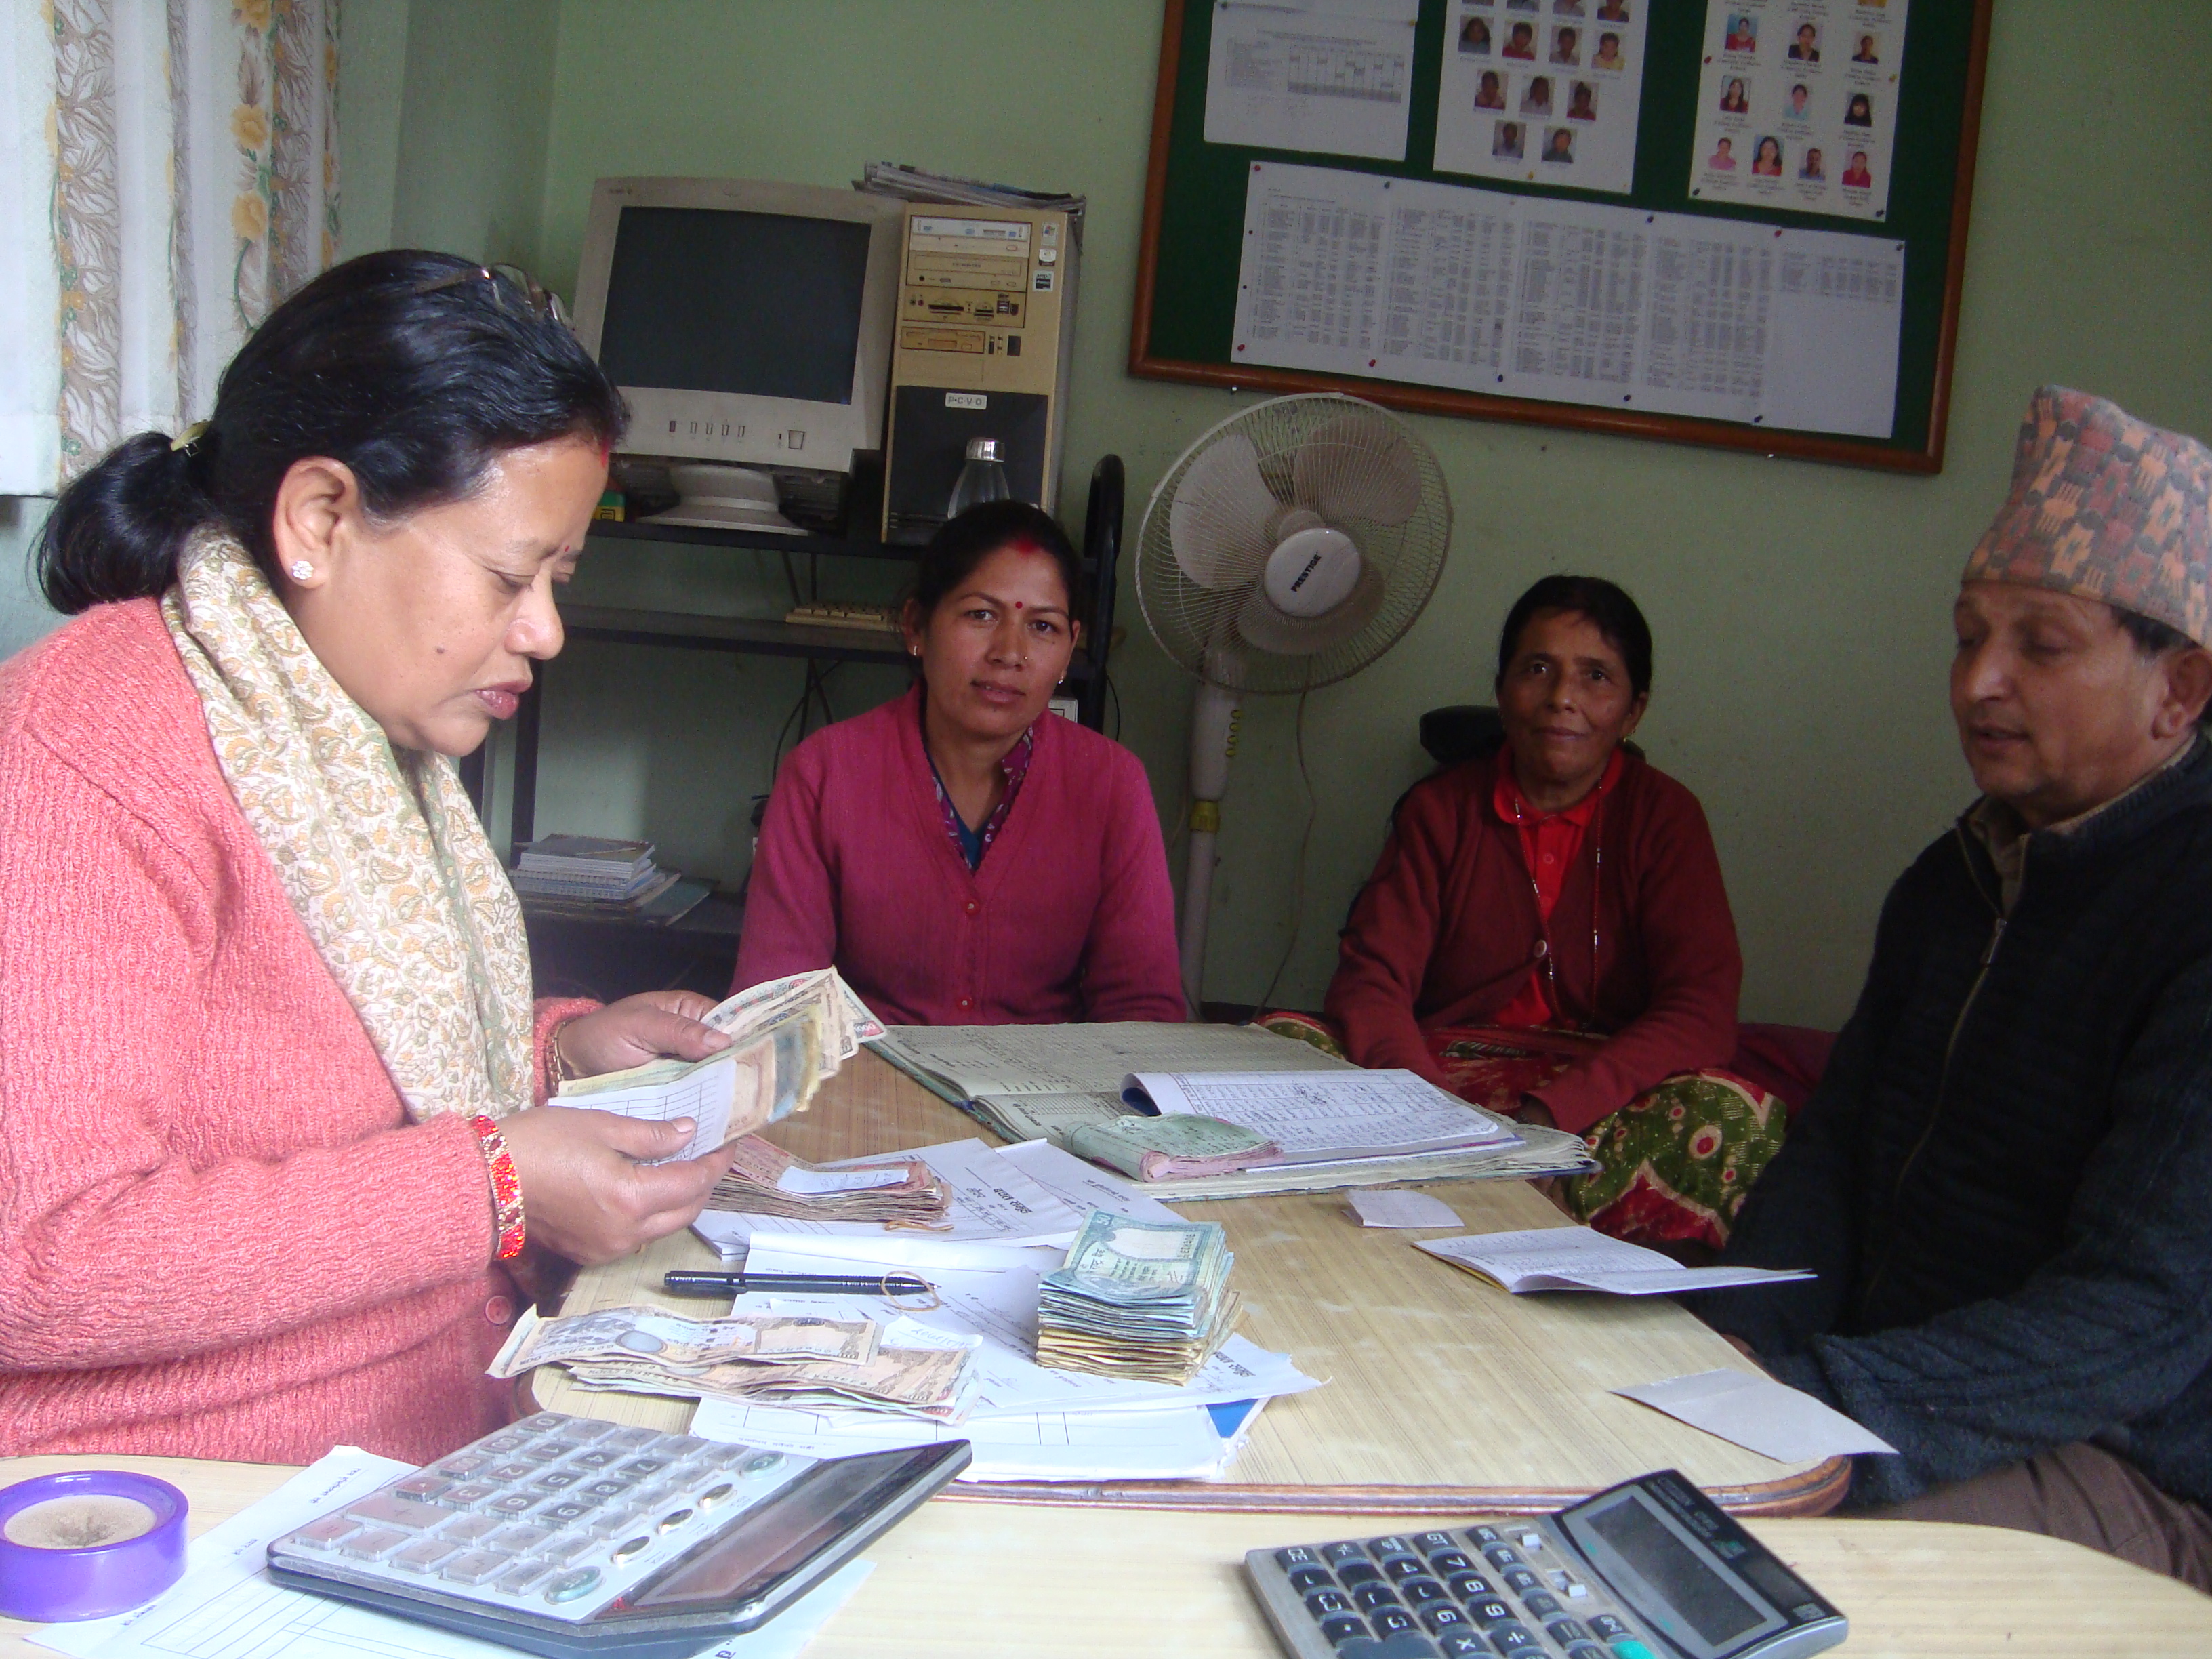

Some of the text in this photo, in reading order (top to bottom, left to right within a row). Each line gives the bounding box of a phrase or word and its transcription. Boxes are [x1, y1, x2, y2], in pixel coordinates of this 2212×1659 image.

[1290, 554, 1322, 592] PRESTIGE
[536, 1418, 556, 1426] 0
[586, 1454, 605, 1464] 4
[499, 1467, 523, 1476] 2
[636, 1463, 657, 1472] 7
[547, 1475, 568, 1486] 5
[457, 1488, 481, 1498] 3
[595, 1484, 619, 1494] 8
[506, 1497, 528, 1507] 6
[557, 1507, 580, 1517] 9
[1426, 1532, 1449, 1545] GT
[1288, 1548, 1309, 1562] CE
[1446, 1557, 1467, 1568] 7
[1465, 1578, 1485, 1592] 8
[1484, 1603, 1506, 1617] 9
[1436, 1609, 1458, 1623] 6
